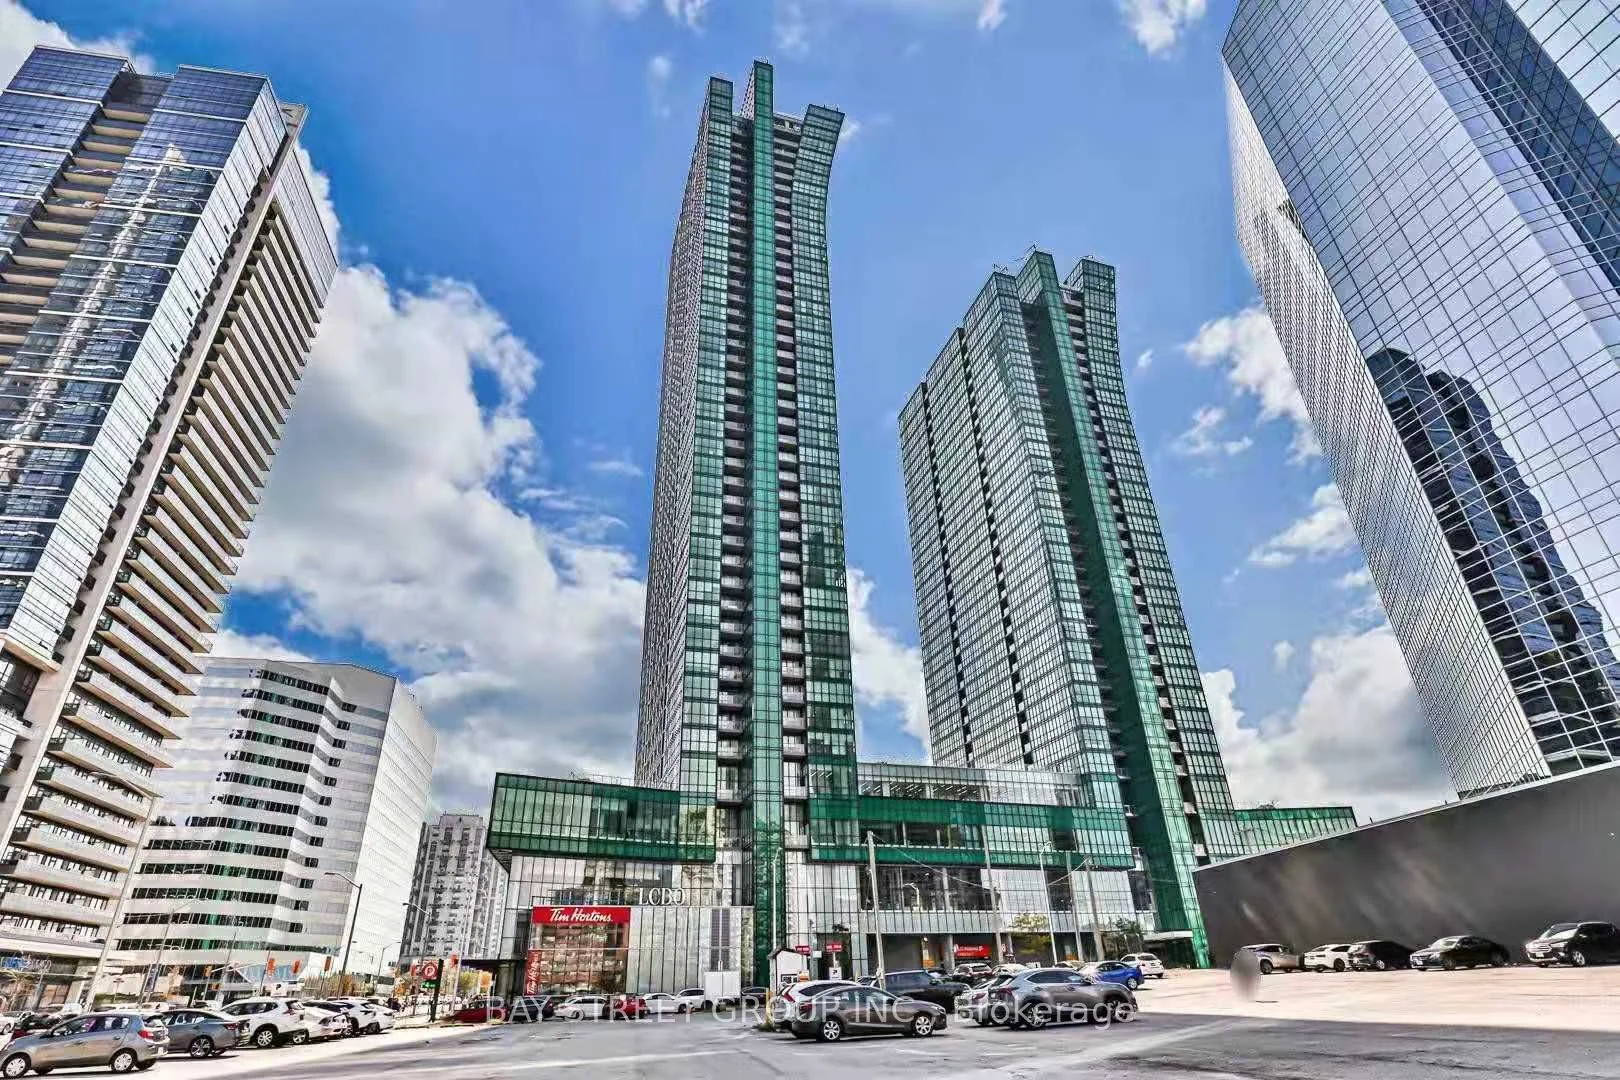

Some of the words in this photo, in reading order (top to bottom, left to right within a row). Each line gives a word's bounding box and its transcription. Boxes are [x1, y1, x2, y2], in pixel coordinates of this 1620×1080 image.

[639, 887, 686, 906] LCBO
[549, 908, 569, 922] Tim
[570, 908, 612, 923] Hortons
